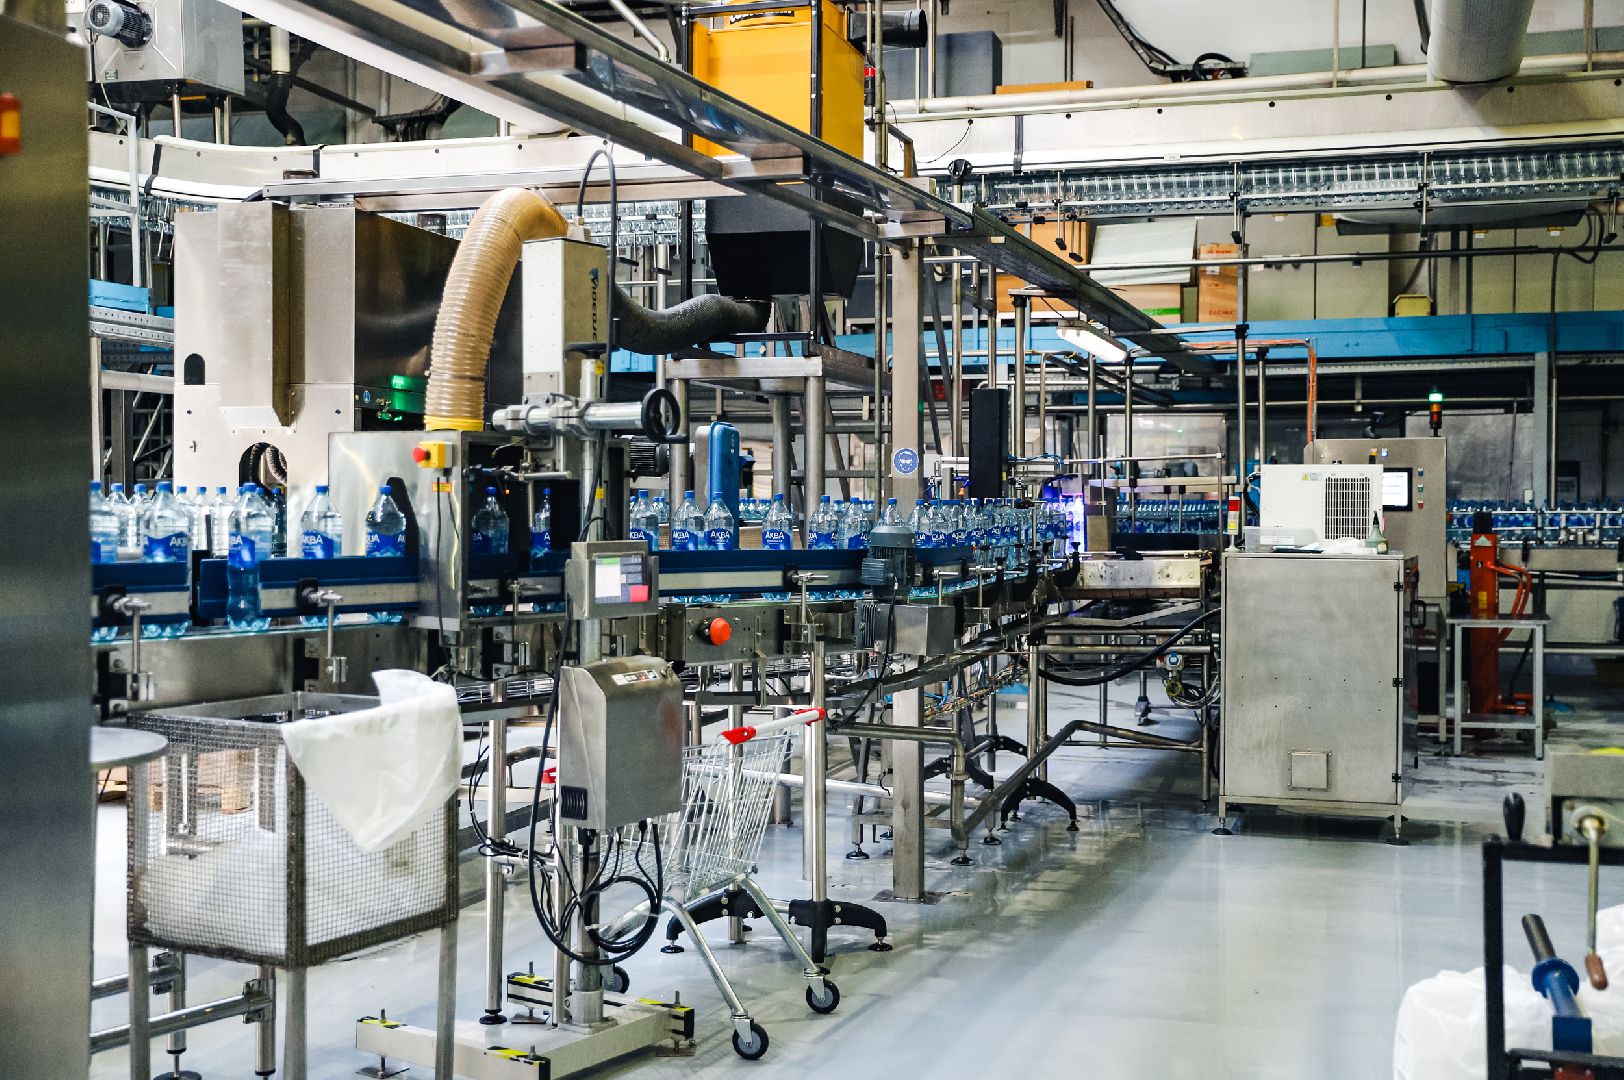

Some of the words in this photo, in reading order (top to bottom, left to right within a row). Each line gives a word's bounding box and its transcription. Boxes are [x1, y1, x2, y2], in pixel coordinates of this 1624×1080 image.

[591, 275, 599, 343] VIDEOJE
[629, 531, 645, 540] КВА
[710, 530, 730, 539] АКВА
[765, 531, 785, 540] АКВА
